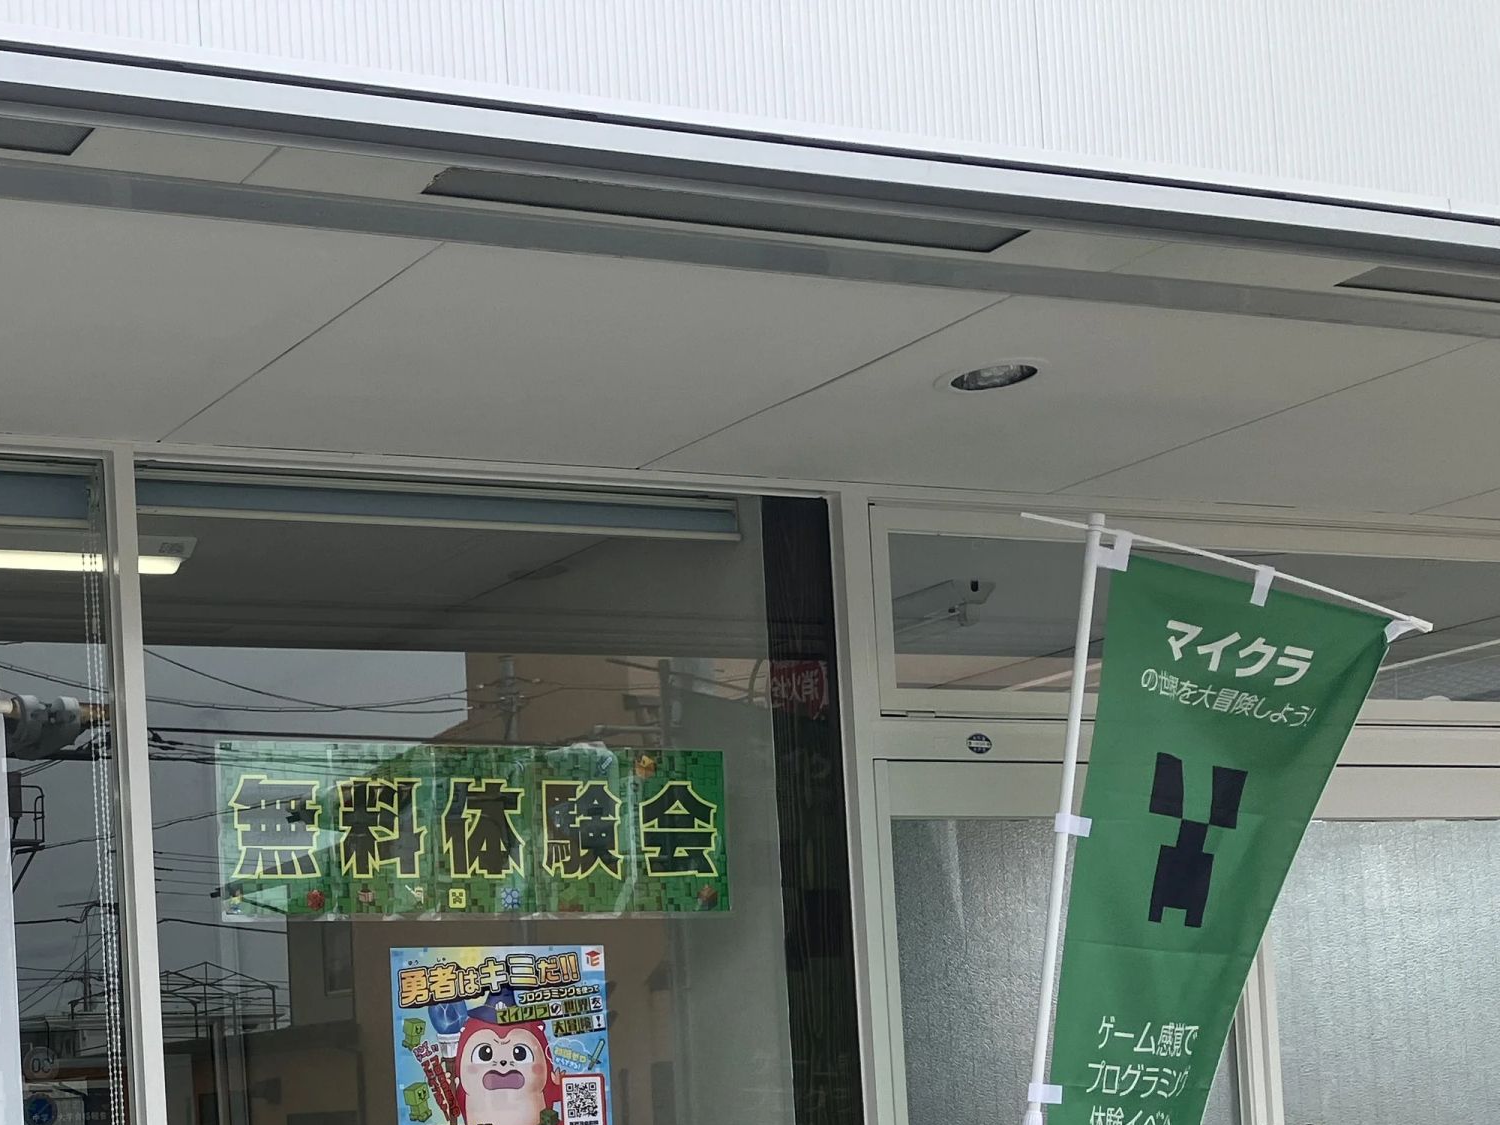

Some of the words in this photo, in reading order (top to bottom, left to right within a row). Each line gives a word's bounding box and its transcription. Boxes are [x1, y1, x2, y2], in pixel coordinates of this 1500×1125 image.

[1166, 619, 1314, 686] マイクラ
[228, 774, 718, 880] 無料体験会
[1098, 1015, 1199, 1057] ゲーム感覚で
